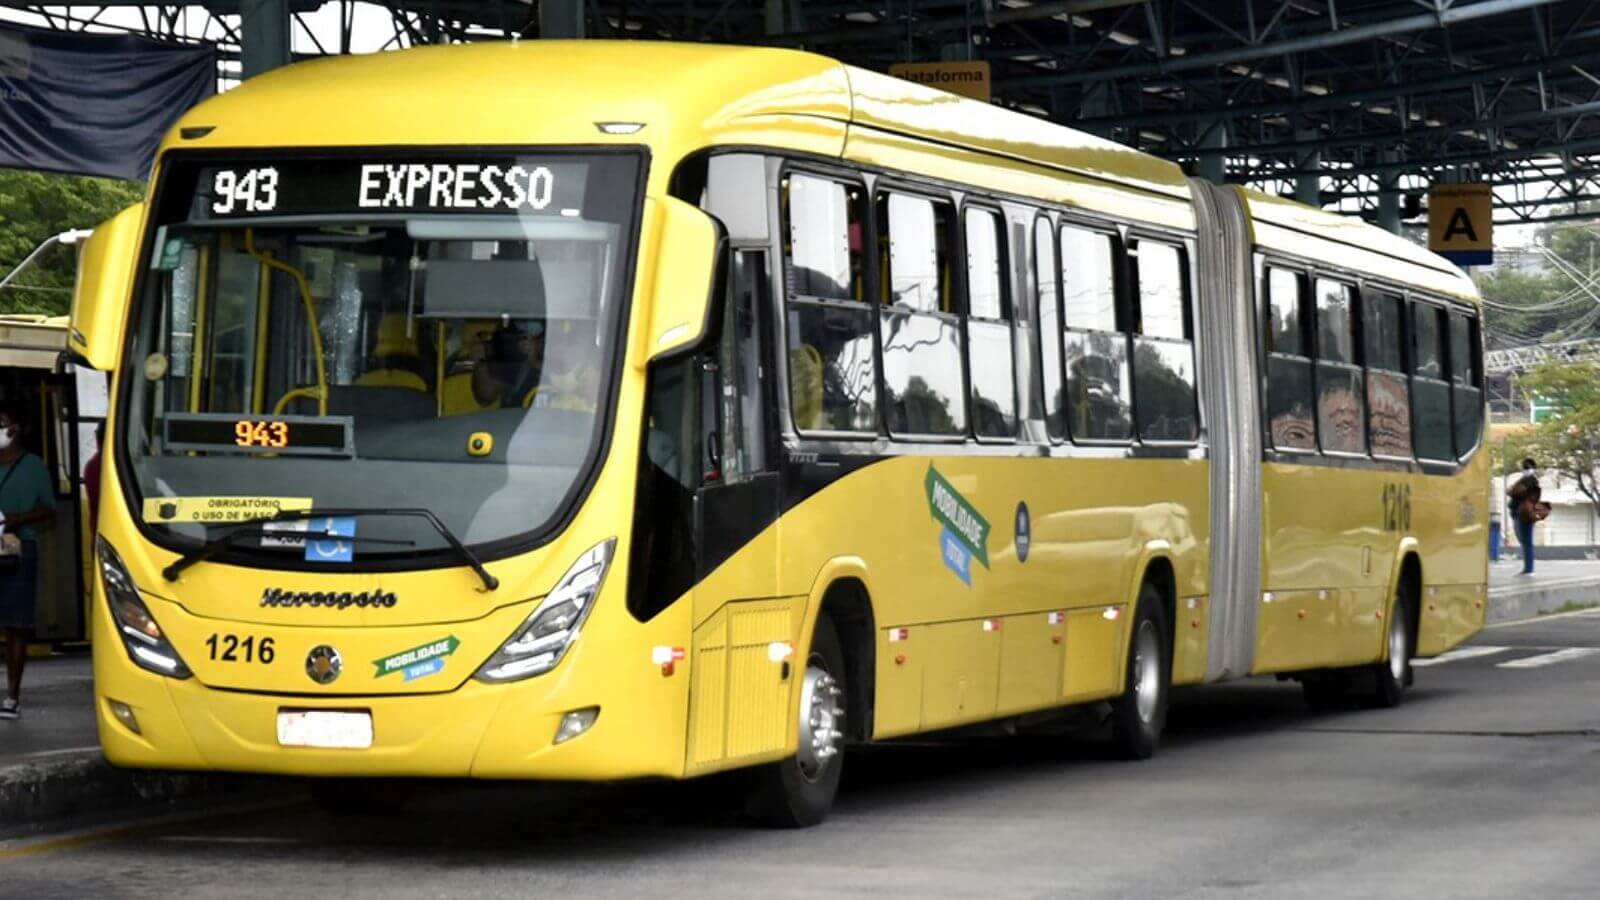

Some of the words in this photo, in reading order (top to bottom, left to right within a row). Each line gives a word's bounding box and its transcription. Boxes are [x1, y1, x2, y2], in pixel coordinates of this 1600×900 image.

[213, 165, 278, 214] 943
[358, 164, 554, 209] EXPRESSO
[1443, 207, 1478, 242] A
[235, 420, 288, 448] 943
[192, 511, 200, 520] O
[202, 511, 224, 520] USO
[226, 511, 239, 520] DE
[1382, 483, 1411, 531] 1216
[205, 633, 275, 665] 1216
[384, 640, 450, 671] MOBILIDADE
[410, 661, 435, 677] TOTAL
